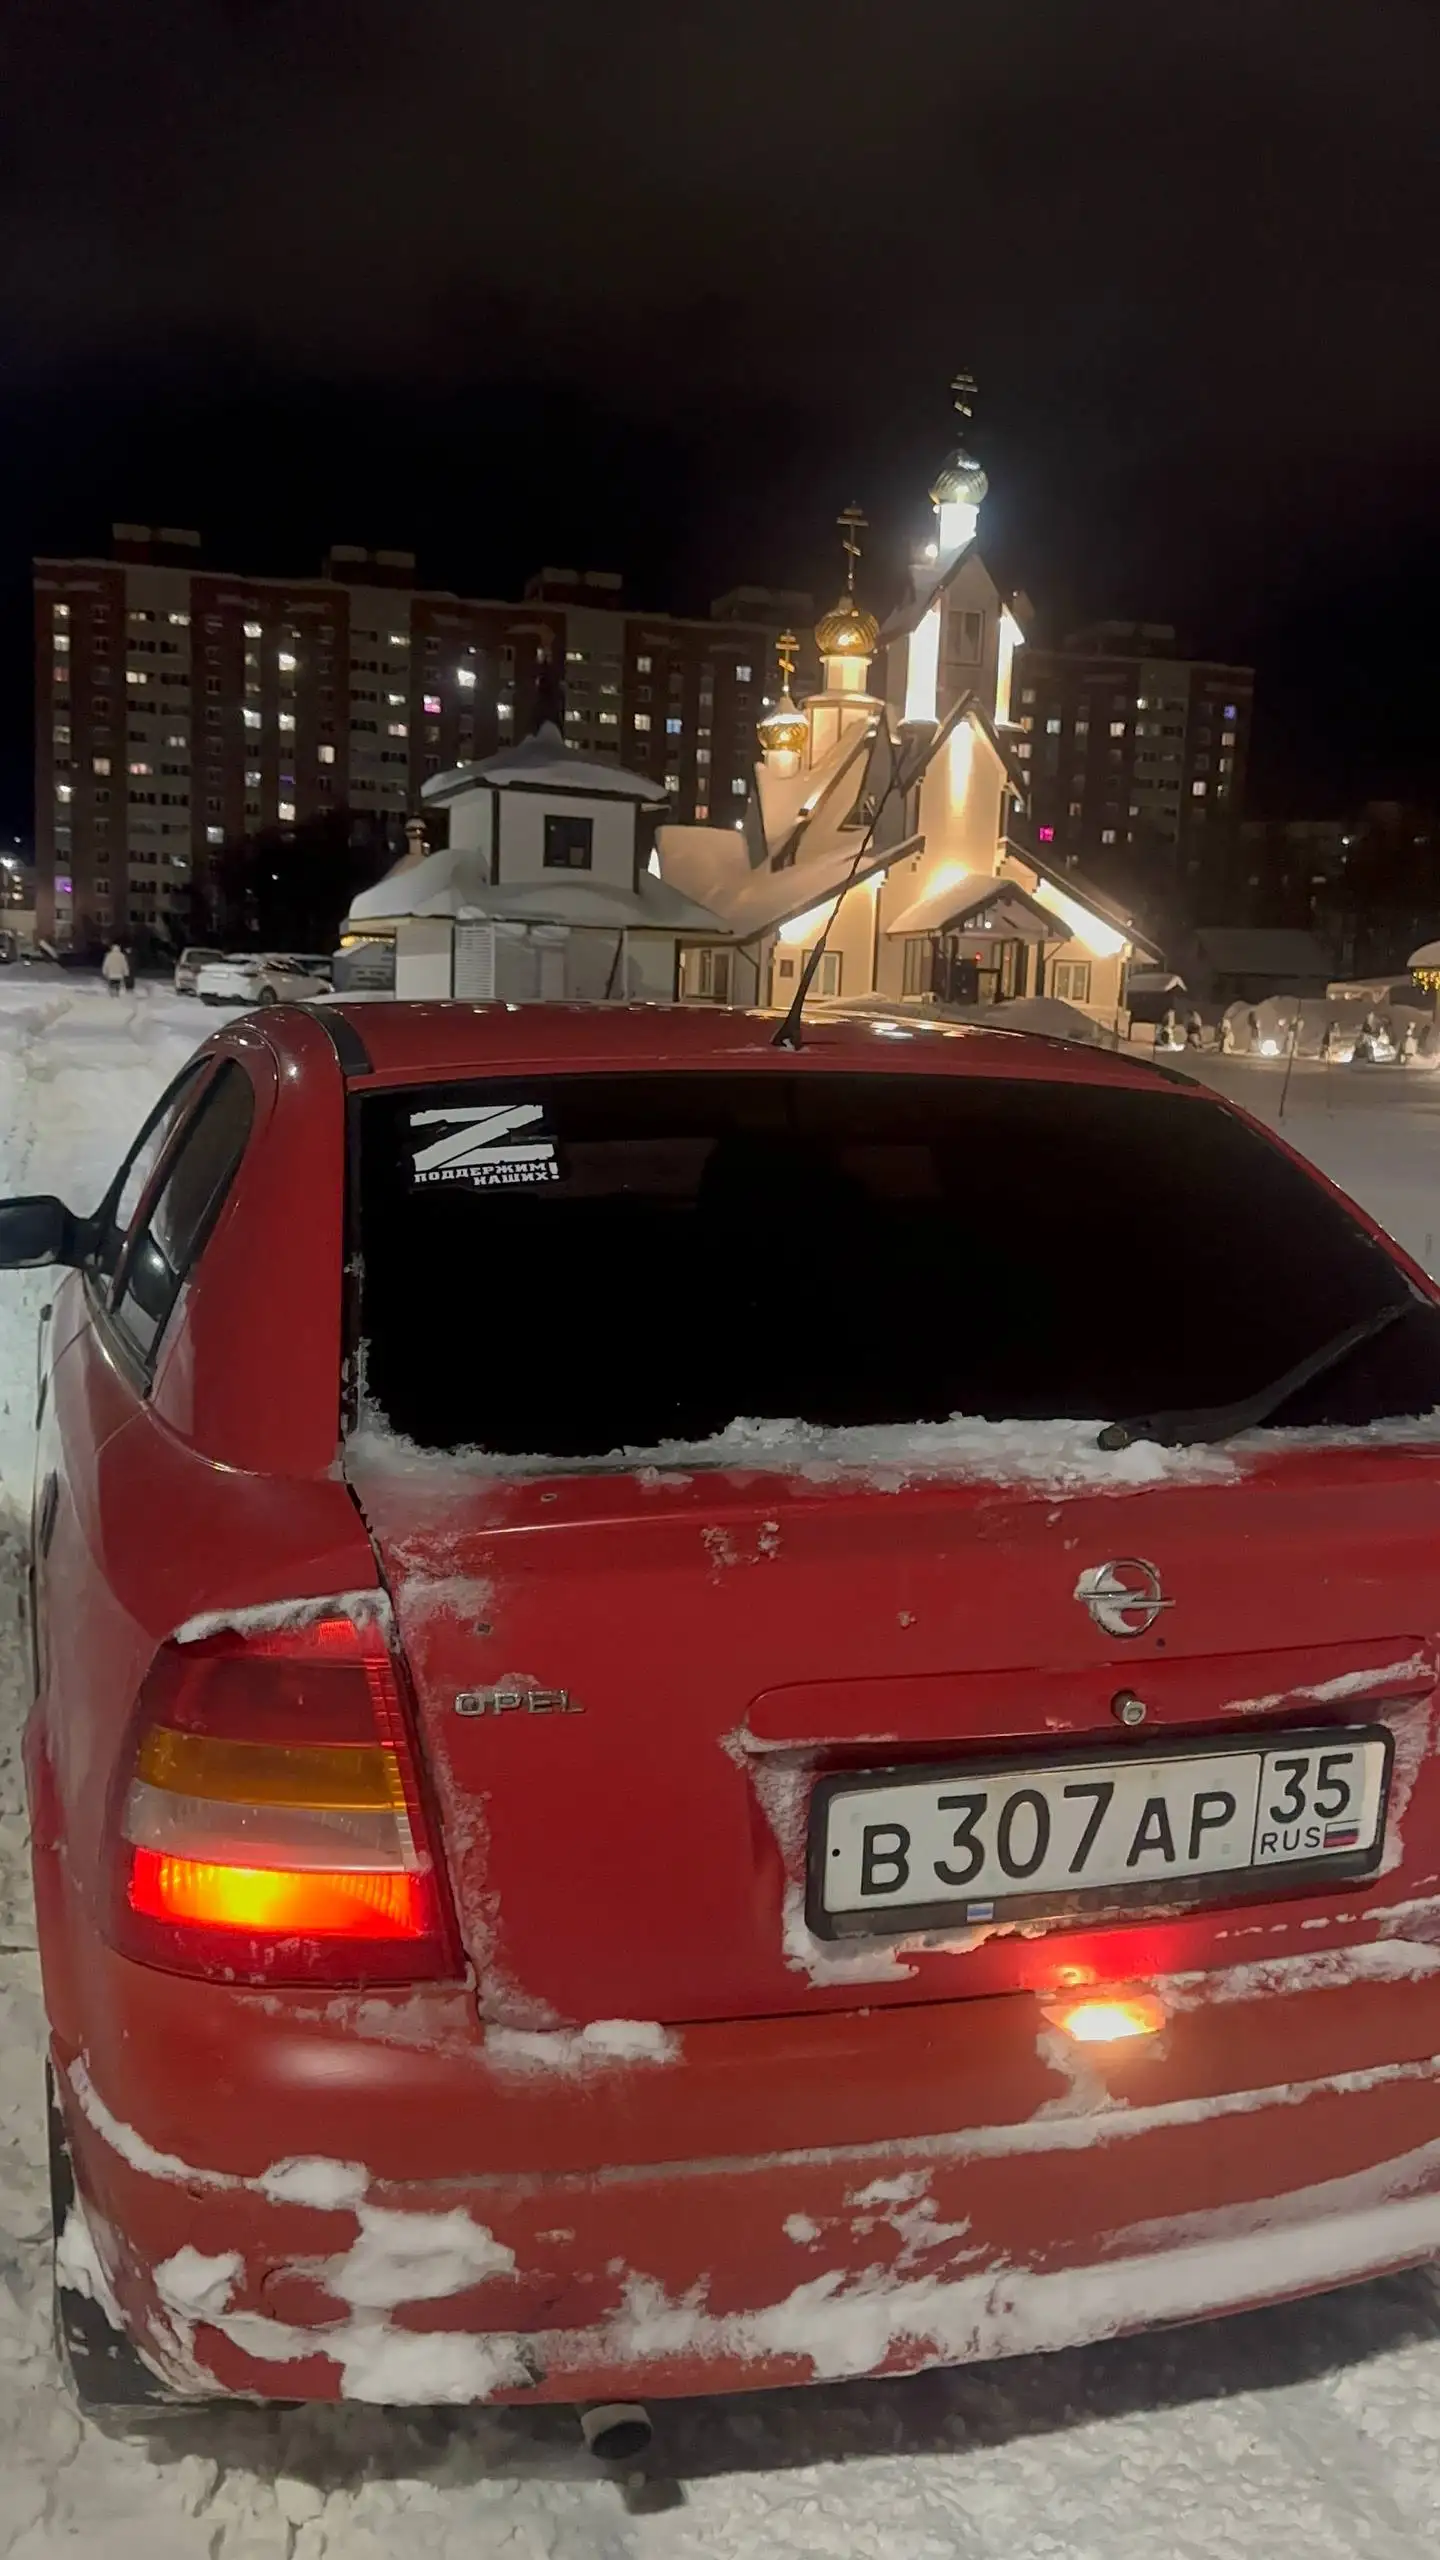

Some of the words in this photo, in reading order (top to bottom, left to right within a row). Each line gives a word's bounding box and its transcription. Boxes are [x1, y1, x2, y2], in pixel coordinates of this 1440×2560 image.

[409, 1104, 555, 1172] Z
[455, 1689, 585, 1716] OPEL
[1269, 1752, 1353, 1825] 35
[1259, 1825, 1321, 1856] RUS
